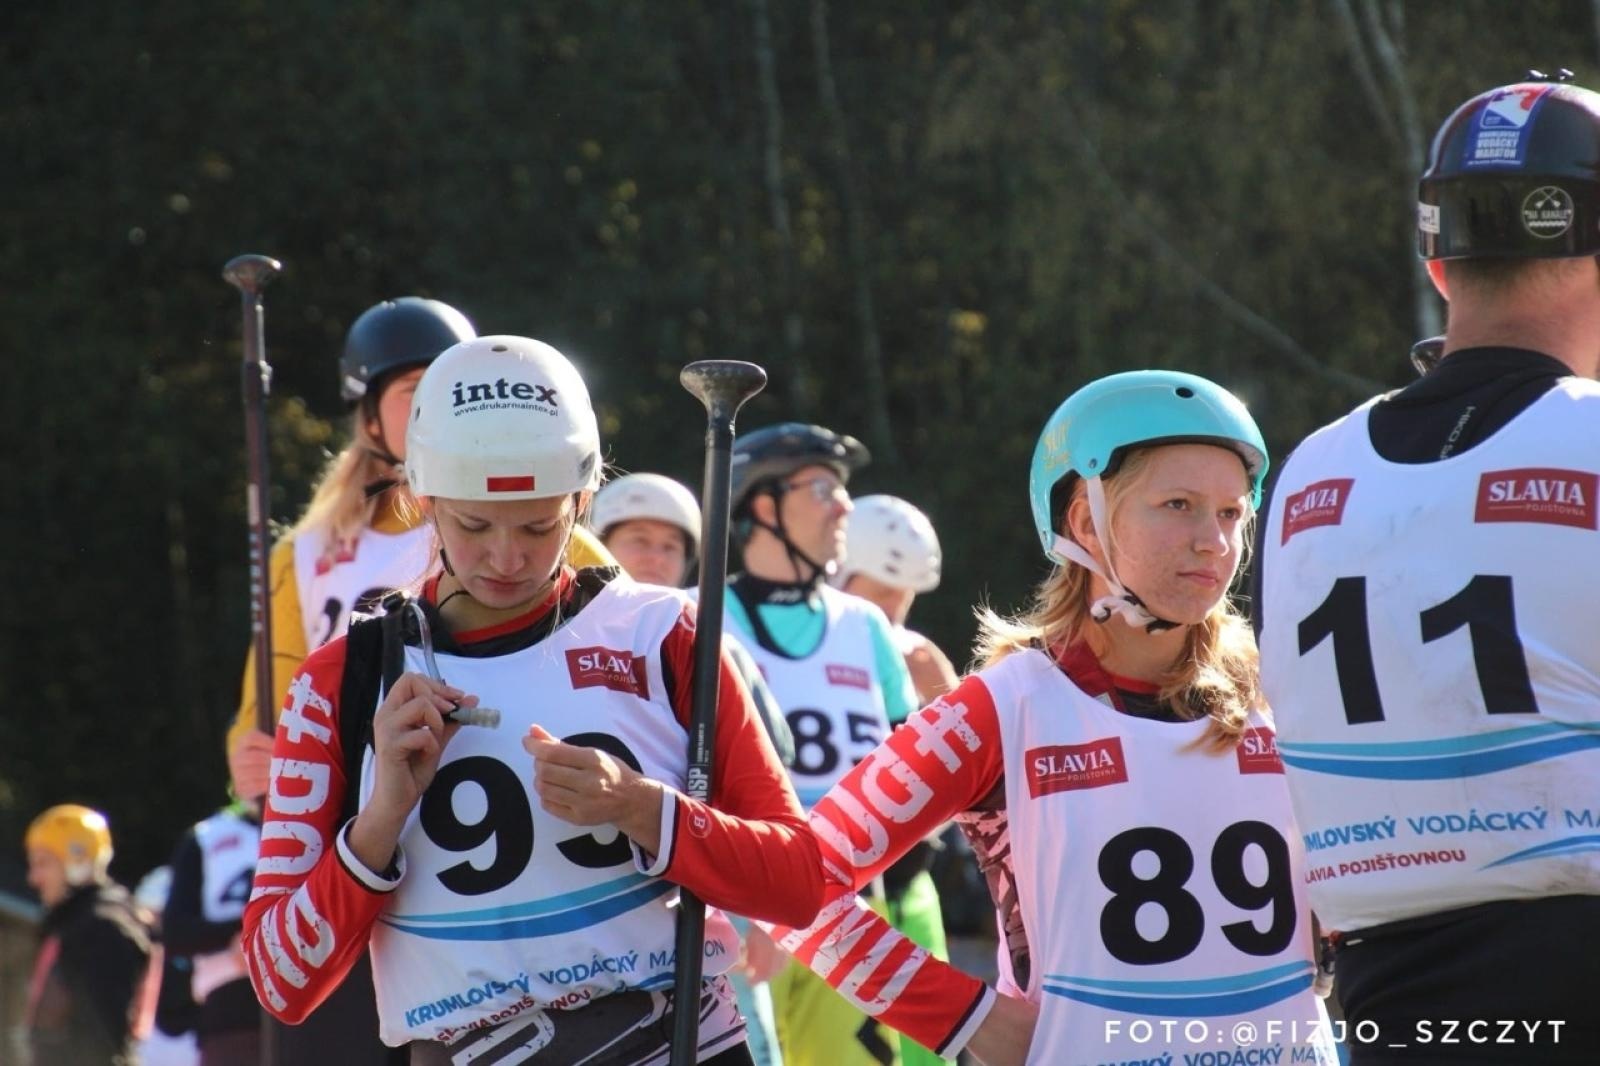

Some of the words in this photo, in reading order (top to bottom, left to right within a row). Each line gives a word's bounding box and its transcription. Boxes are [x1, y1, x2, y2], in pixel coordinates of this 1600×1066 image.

[452, 378, 557, 407] intex
[455, 402, 558, 417] www.drukarniaintex.pl
[1288, 488, 1339, 522] SAVIA
[1488, 479, 1586, 506] SLAVIA
[1297, 574, 1539, 726] 11
[578, 652, 638, 684] SLAV
[785, 707, 881, 777] 85
[1243, 735, 1280, 756] SLA
[1034, 748, 1115, 777] SLAVIA
[1303, 814, 1396, 852] MLOVSKÝ
[1407, 806, 1548, 836] VODÁCKÝ
[1304, 865, 1337, 884] LAVIA
[1339, 848, 1467, 877] POJIŠŤOVNOU
[1098, 819, 1298, 966] 89
[405, 972, 530, 1028] KRUMLOVSÝ
[539, 950, 640, 985] VODÁCKÝ
[650, 940, 726, 969] MAON
